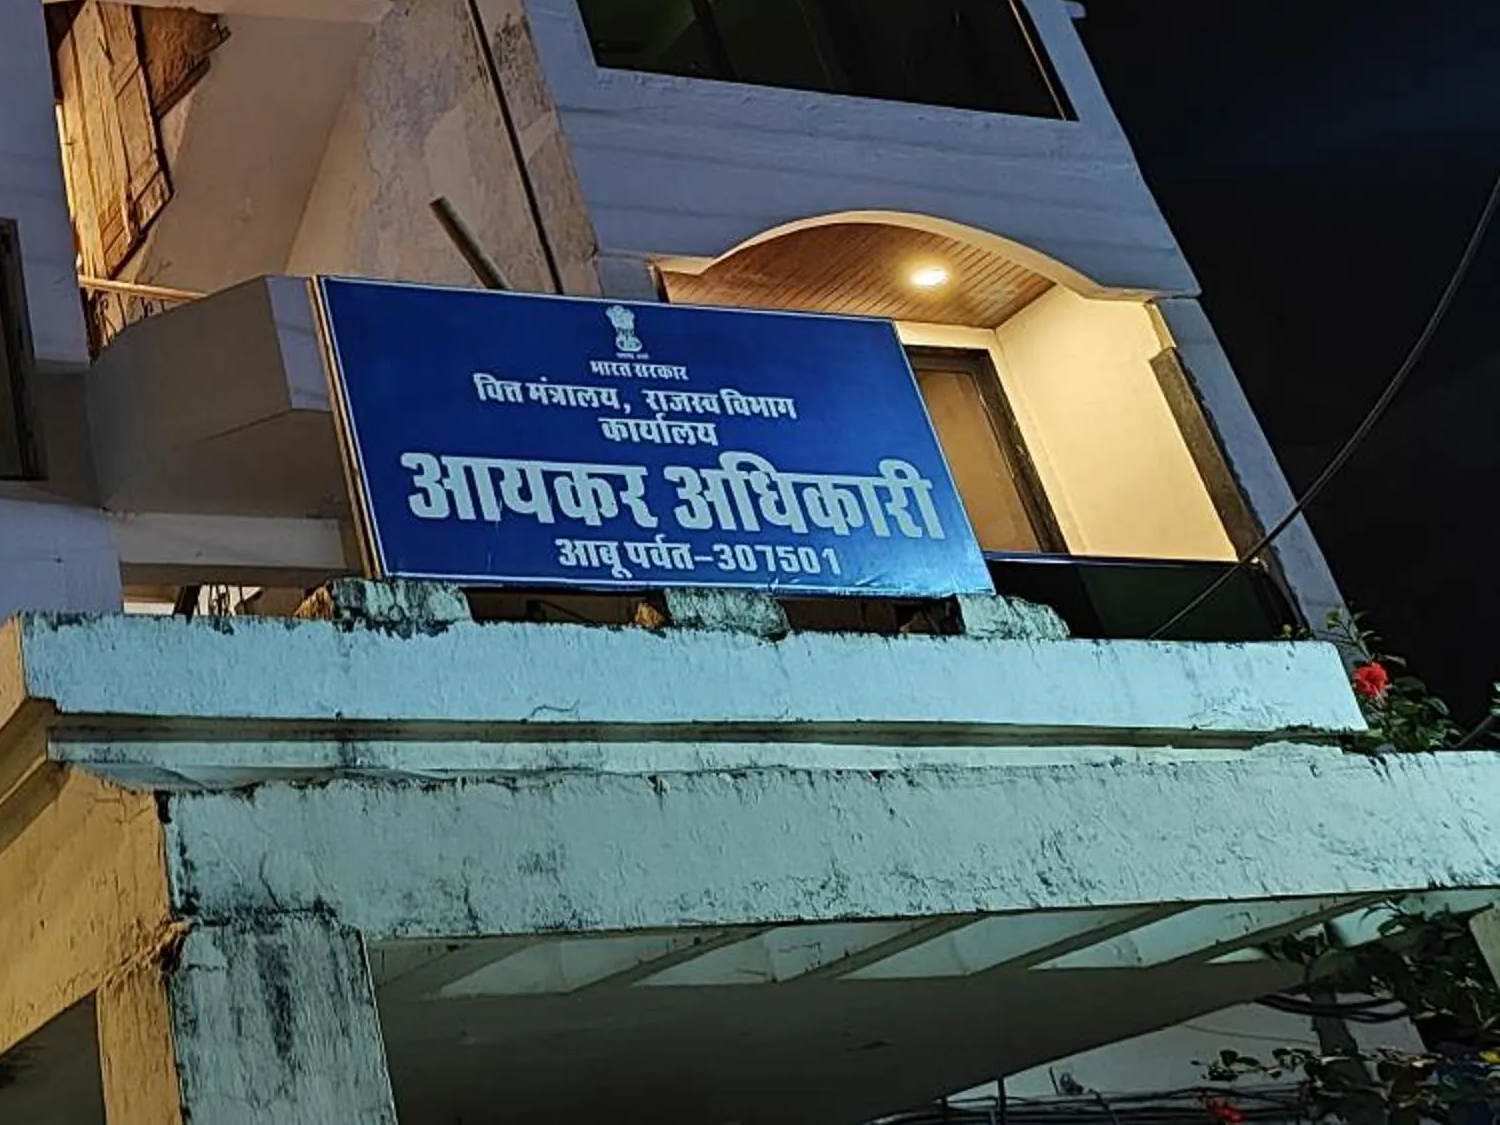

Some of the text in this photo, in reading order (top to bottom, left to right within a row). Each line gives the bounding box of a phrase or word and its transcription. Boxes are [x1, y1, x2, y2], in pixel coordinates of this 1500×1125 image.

[589, 360, 689, 381] भारत सरकार
[473, 373, 524, 403] वित्त
[641, 389, 721, 415] राजस्व
[718, 388, 797, 419] विभाग
[597, 413, 719, 446] कार्यालय
[401, 451, 946, 541] आयकर अधिकारी
[555, 539, 633, 579] आबू
